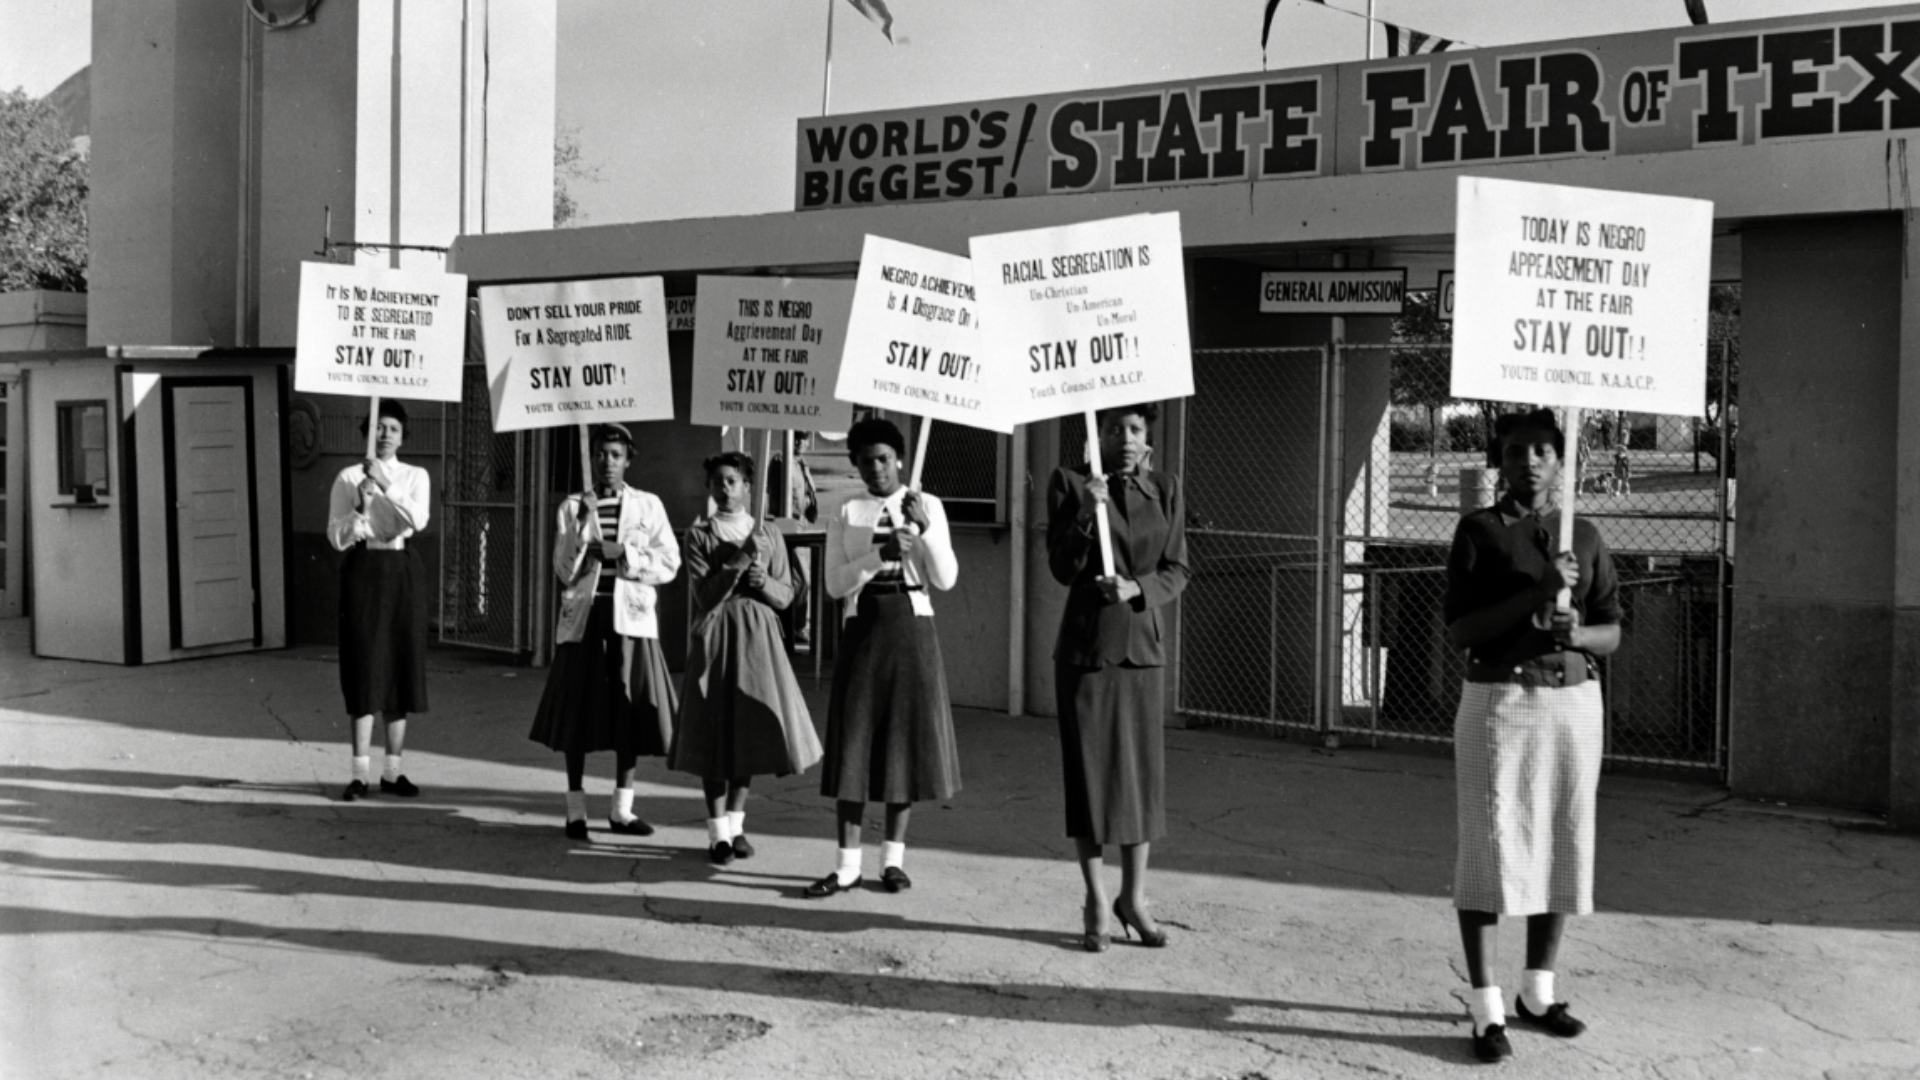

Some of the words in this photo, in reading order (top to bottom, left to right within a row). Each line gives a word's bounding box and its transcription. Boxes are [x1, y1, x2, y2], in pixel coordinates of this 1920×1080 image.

[1048, 77, 1320, 190] STATE
[1363, 50, 1614, 168] FAIR
[1621, 69, 1671, 127] OF
[806, 108, 1010, 163] WORLD'S
[1521, 215, 1569, 244] TODAY
[1576, 221, 1591, 246] IS
[1599, 223, 1646, 252] NEGRO
[881, 265, 918, 287] NEGRO
[1002, 258, 1047, 285] RACIAL
[1052, 247, 1134, 278] SEGREGATION
[1138, 245, 1150, 267] IS
[1509, 250, 1613, 285] APPEASEMENT
[1622, 261, 1651, 288] DAY
[370, 287, 440, 307] ACHIEVEMENT
[1029, 285, 1088, 301] Un-Christian
[1264, 280, 1324, 302] GENERAL
[1328, 279, 1402, 302] ADMISSION
[1537, 288, 1557, 309] AT
[1564, 290, 1594, 312] THE
[1599, 293, 1633, 315] FAIR
[337, 305, 349, 321] TO
[354, 306, 366, 322] BE
[371, 307, 433, 326] SEGREGATED
[507, 306, 541, 321] DON'T
[544, 304, 572, 320] SELL
[575, 302, 606, 317] YOUR
[609, 300, 642, 316] PRIDE
[739, 299, 759, 317] THIS
[764, 300, 773, 318] IS
[778, 300, 813, 319] NEGRO
[900, 294, 908, 313] A
[913, 297, 955, 323] Disgrace
[958, 307, 971, 327] On
[1066, 297, 1123, 314] Un-American
[1097, 310, 1137, 327] Un-Moral
[352, 325, 366, 338] AT
[370, 326, 389, 340] THE
[394, 327, 416, 341] FAIR
[515, 329, 531, 346] For
[536, 328, 544, 345] A
[546, 325, 602, 347] Segregated
[605, 323, 632, 341] RIDE
[727, 321, 796, 342] Aggrievement
[802, 324, 823, 345] Day
[1514, 318, 1571, 355] STAY
[335, 345, 374, 366] STAY
[742, 347, 756, 362] AT
[761, 348, 781, 363] THE
[784, 349, 808, 365] FAIR
[886, 340, 931, 372] STAY
[1029, 339, 1077, 373] STAY
[327, 372, 353, 382] YOUTH
[357, 373, 390, 385] COUNCIL
[530, 366, 571, 390] STAY
[727, 369, 765, 393] STAY
[1500, 364, 1538, 381] YOUTH
[1545, 368, 1595, 386] COUNCIL
[873, 378, 900, 394] YOUTH
[904, 385, 940, 403] COUNCIL
[1030, 384, 1056, 400] Youth
[1061, 378, 1095, 395] Council
[525, 402, 553, 414] YOUTH
[558, 400, 593, 412] COUNCIL
[720, 401, 744, 412] YOUTH
[749, 402, 781, 414] COUNCIL
